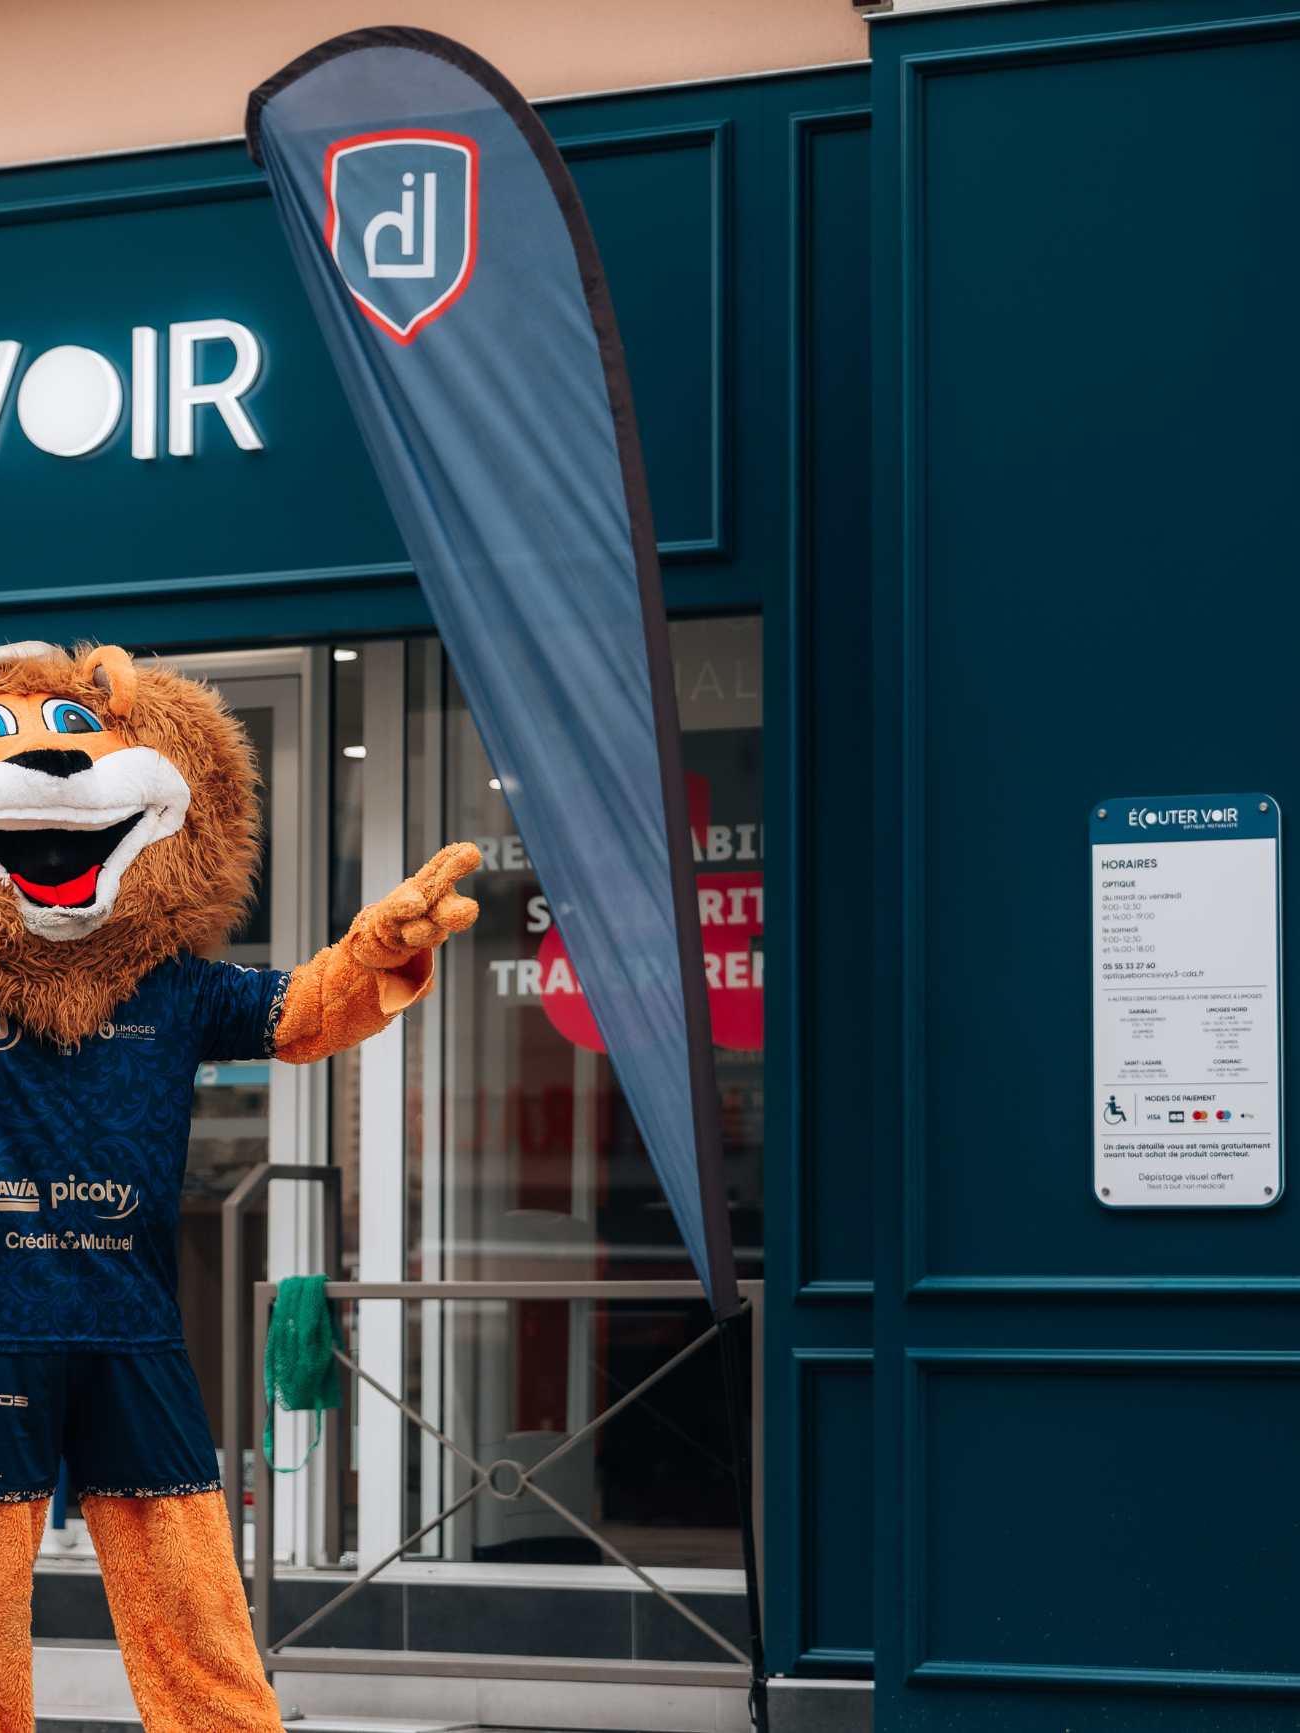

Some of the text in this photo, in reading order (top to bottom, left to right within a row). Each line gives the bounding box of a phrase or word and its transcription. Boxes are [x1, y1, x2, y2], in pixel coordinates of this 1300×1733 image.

[1128, 808, 1238, 829] ÉCOUTER VOIR
[1101, 858, 1158, 870] HORAIRES
[1102, 880, 1136, 889] OPTIQUE
[115, 1024, 156, 1034] LIMOGES
[1115, 1142, 1135, 1150] devis
[1221, 1142, 1271, 1151] gratuitement
[1180, 1150, 1207, 1159] produit
[1138, 1172, 1234, 1182] Dépistage visuel offert
[50, 1174, 132, 1210] picoty
[5, 1231, 133, 1250] Crédit Mutuel
